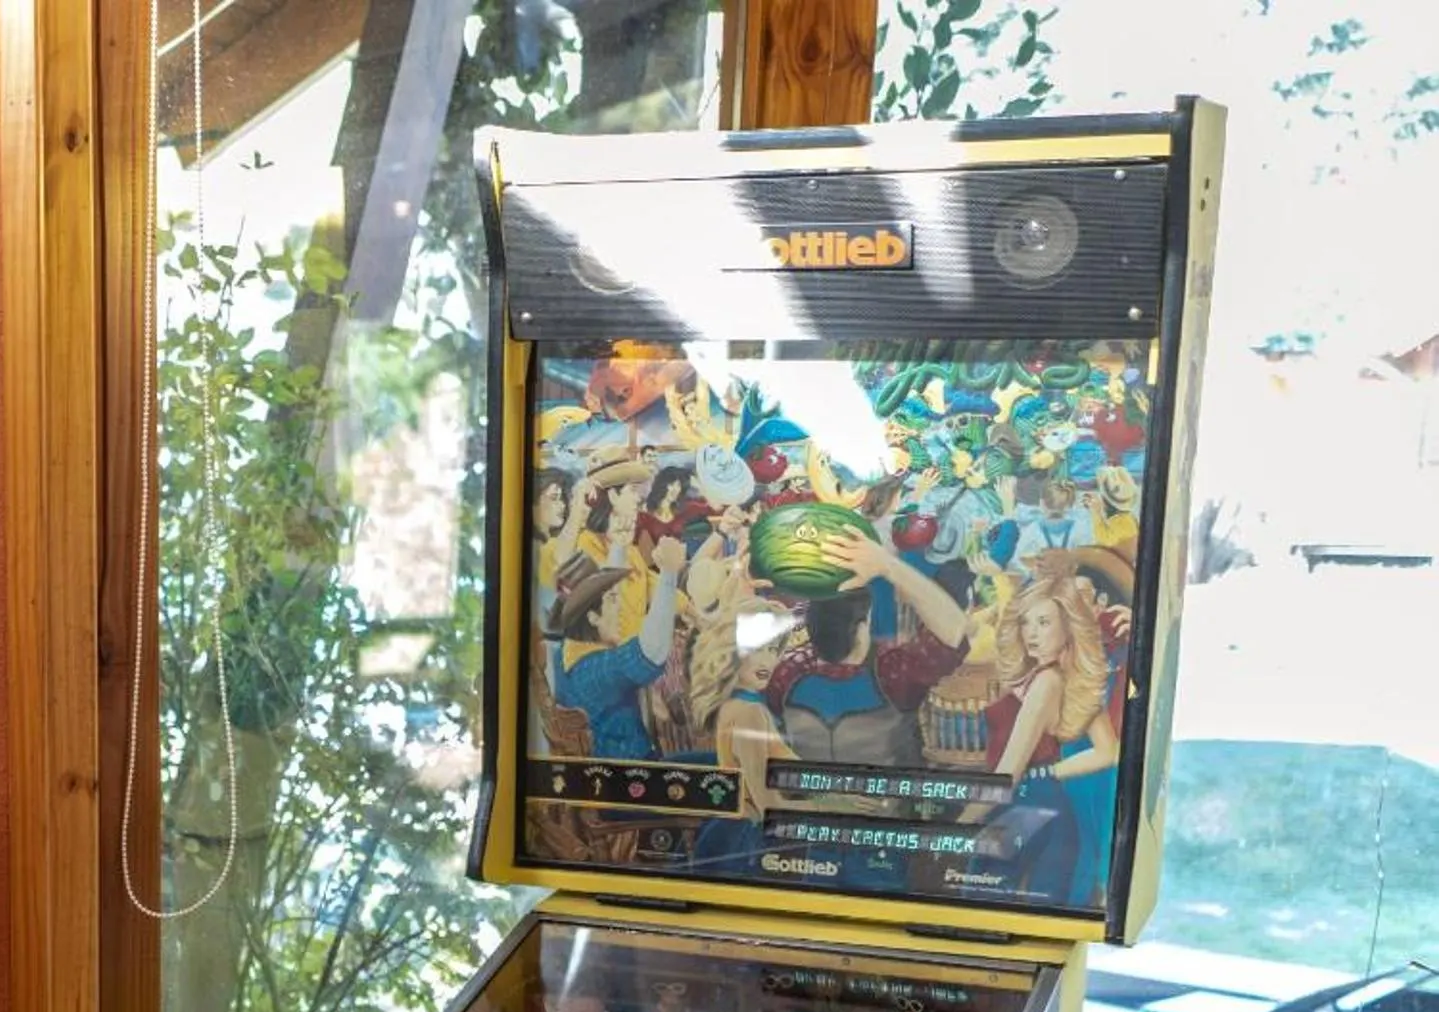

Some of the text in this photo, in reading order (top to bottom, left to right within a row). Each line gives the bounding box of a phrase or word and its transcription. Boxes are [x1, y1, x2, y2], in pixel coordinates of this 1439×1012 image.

[762, 229, 906, 268] ottlieb
[866, 778, 888, 795] BE
[898, 780, 911, 796] A
[921, 781, 969, 800] SACK
[929, 834, 977, 853] JACK
[761, 853, 839, 877] Gottlieb
[944, 869, 1003, 887] Premier
